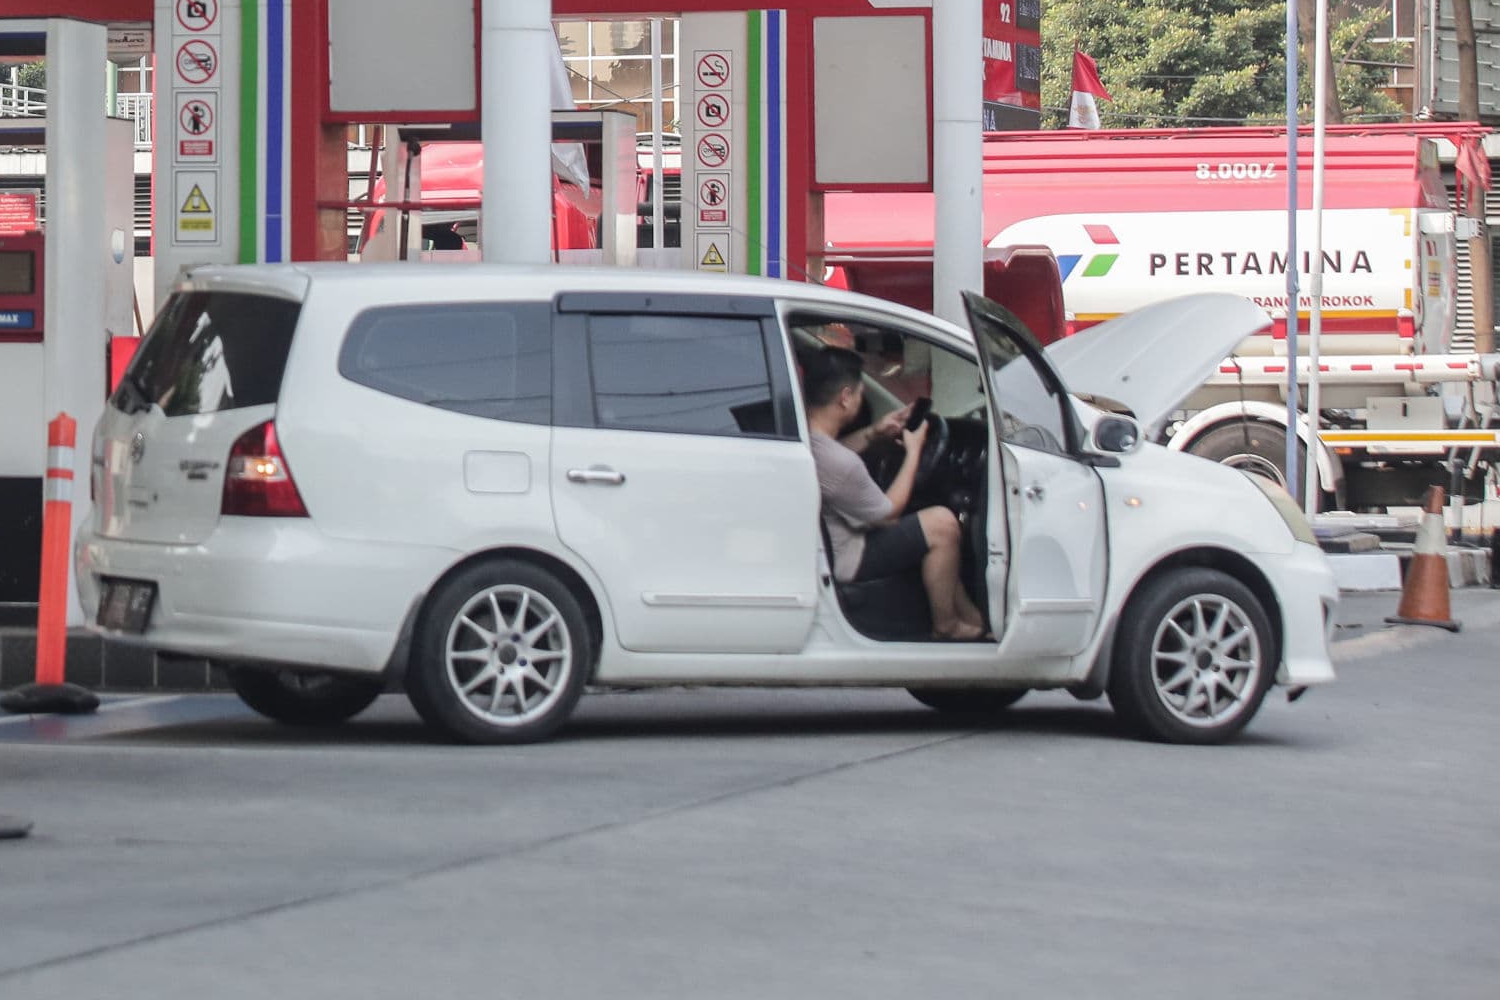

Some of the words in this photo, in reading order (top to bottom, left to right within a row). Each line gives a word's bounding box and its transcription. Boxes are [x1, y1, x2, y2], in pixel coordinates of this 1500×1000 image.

[1000, 2, 1011, 23] 92
[982, 38, 1013, 62] TAMINA
[1150, 250, 1373, 277] PERTAMINA
[1300, 295, 1375, 307] MROKOK
